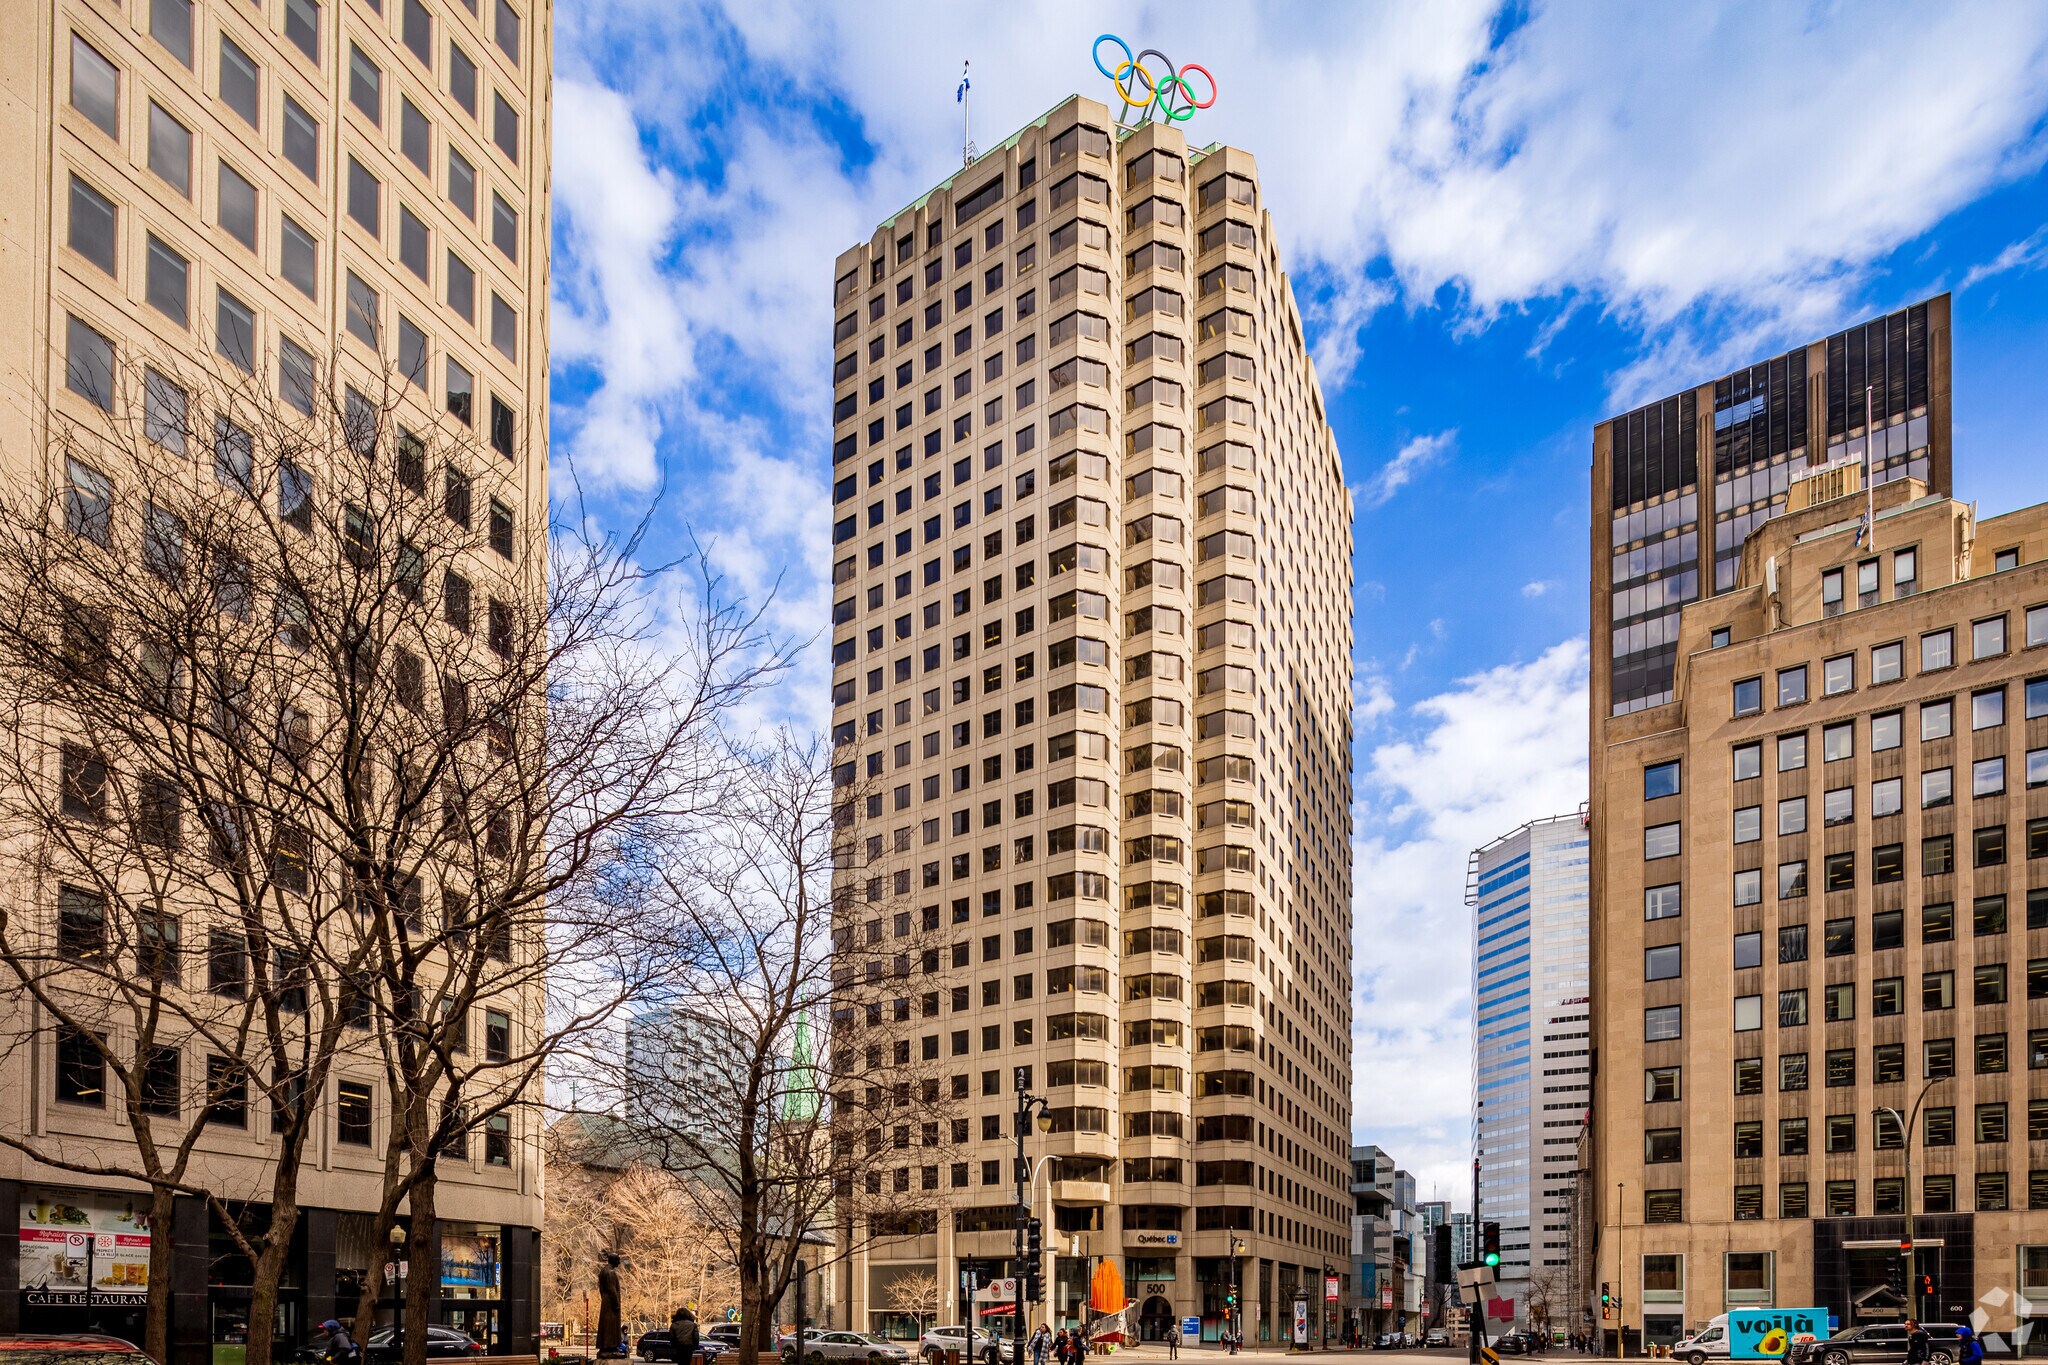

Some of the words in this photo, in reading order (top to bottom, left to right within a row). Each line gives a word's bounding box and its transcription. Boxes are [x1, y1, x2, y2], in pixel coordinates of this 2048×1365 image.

[1138, 1235, 1165, 1244] Québec
[1146, 1283, 1165, 1294] 500
[27, 1293, 63, 1304] CAFE
[1736, 1314, 1814, 1334] voilà
